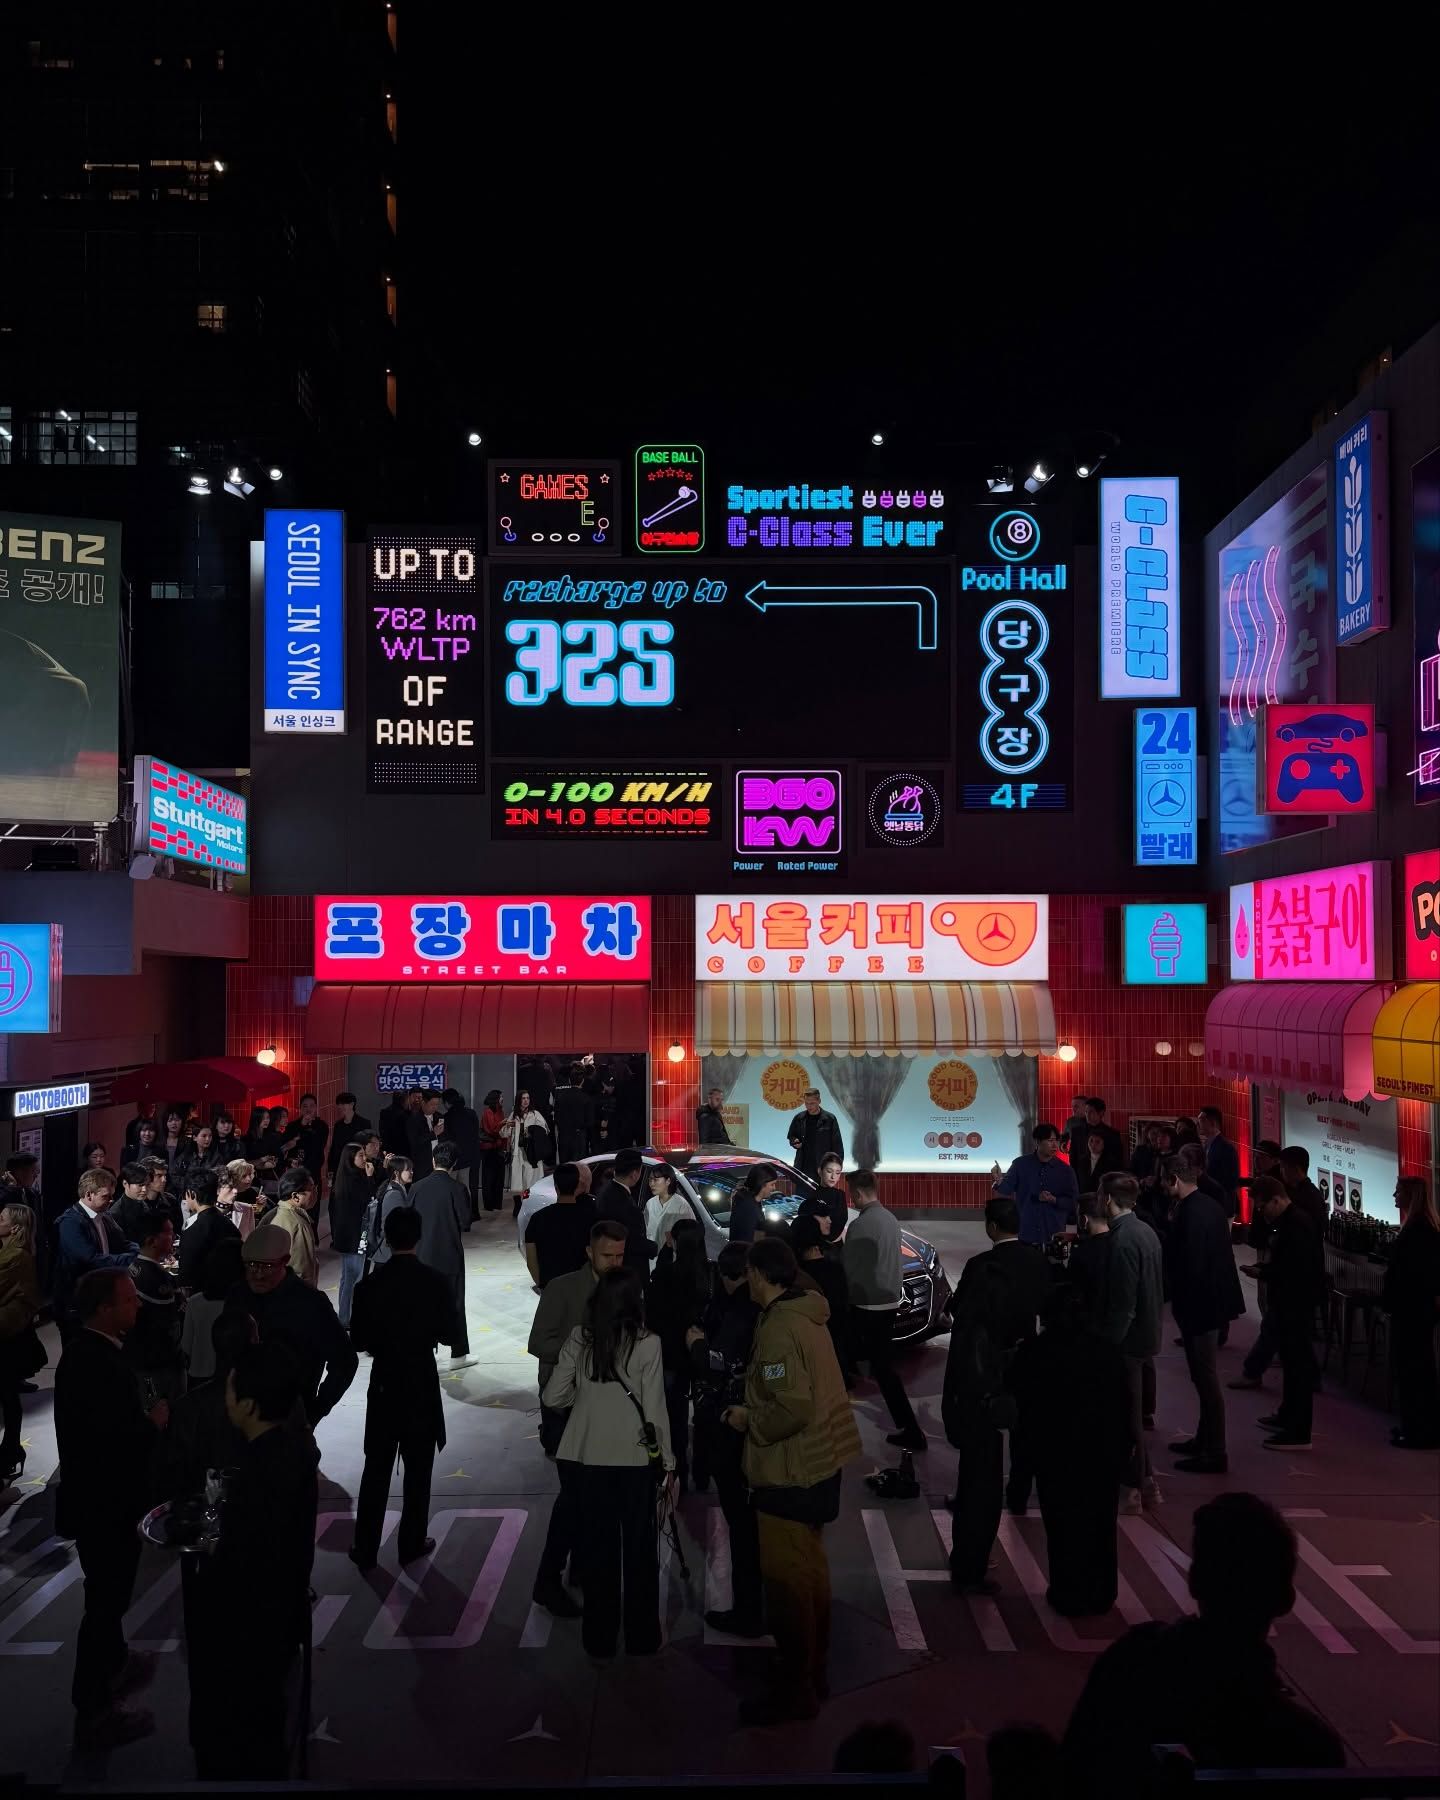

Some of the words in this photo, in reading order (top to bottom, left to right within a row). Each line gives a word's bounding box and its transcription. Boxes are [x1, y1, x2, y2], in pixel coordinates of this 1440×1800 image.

[641, 451, 670, 463] BASE
[671, 451, 700, 463] BALL
[520, 474, 588, 499] GAMES
[727, 484, 853, 513] Sportiest
[727, 516, 853, 547] C-Class
[862, 516, 944, 547] Ever
[0, 527, 105, 566] ENZ
[287, 521, 321, 595] SEOUL
[1110, 521, 1121, 572] WORLD
[375, 548, 421, 580] UP
[429, 548, 475, 580] TO
[962, 564, 1011, 591] Pool
[1019, 564, 1067, 591] Hall
[20, 569, 105, 606] 공개!
[503, 575, 648, 609] recharge
[652, 582, 689, 609] up
[693, 578, 728, 603] to
[287, 604, 321, 633] IN
[373, 607, 426, 631] 762
[436, 607, 476, 631] km
[1110, 580, 1121, 655] PREMIERE
[1339, 603, 1372, 637] BAKERY
[380, 637, 471, 661] WLTP
[287, 642, 321, 700] SYNC
[403, 675, 447, 707] OF
[997, 620, 1032, 756] 당구장
[273, 715, 297, 728] 서울
[300, 715, 336, 728] 인싱크
[375, 719, 475, 748] RANGE
[1142, 712, 1192, 755] 24
[504, 782, 614, 802] 0-100
[620, 782, 713, 802] KM/H
[990, 783, 1039, 809] 4F
[153, 796, 244, 845] Stuttgart
[505, 808, 540, 825] IN
[546, 808, 586, 825] 4.0
[594, 808, 711, 825] SECONDS
[216, 838, 244, 855] Motors
[1141, 832, 1193, 861] 빨래
[733, 861, 765, 871] Power
[777, 861, 806, 871] Rated
[807, 861, 839, 871] Power
[325, 901, 642, 961] 포장마차
[706, 902, 925, 950] 서울커피
[1254, 898, 1262, 959] GRILL
[1267, 874, 1368, 969] 숯불구이
[402, 965, 501, 975] STREET
[519, 965, 568, 975] BAR
[706, 956, 925, 974] COFFEE
[379, 1064, 444, 1076] TASTY!
[379, 1075, 445, 1090] 맛있는음식
[18, 1085, 88, 1115] PHOTOBOOTH
[768, 1078, 800, 1097] 커피
[936, 1078, 968, 1097] 커피
